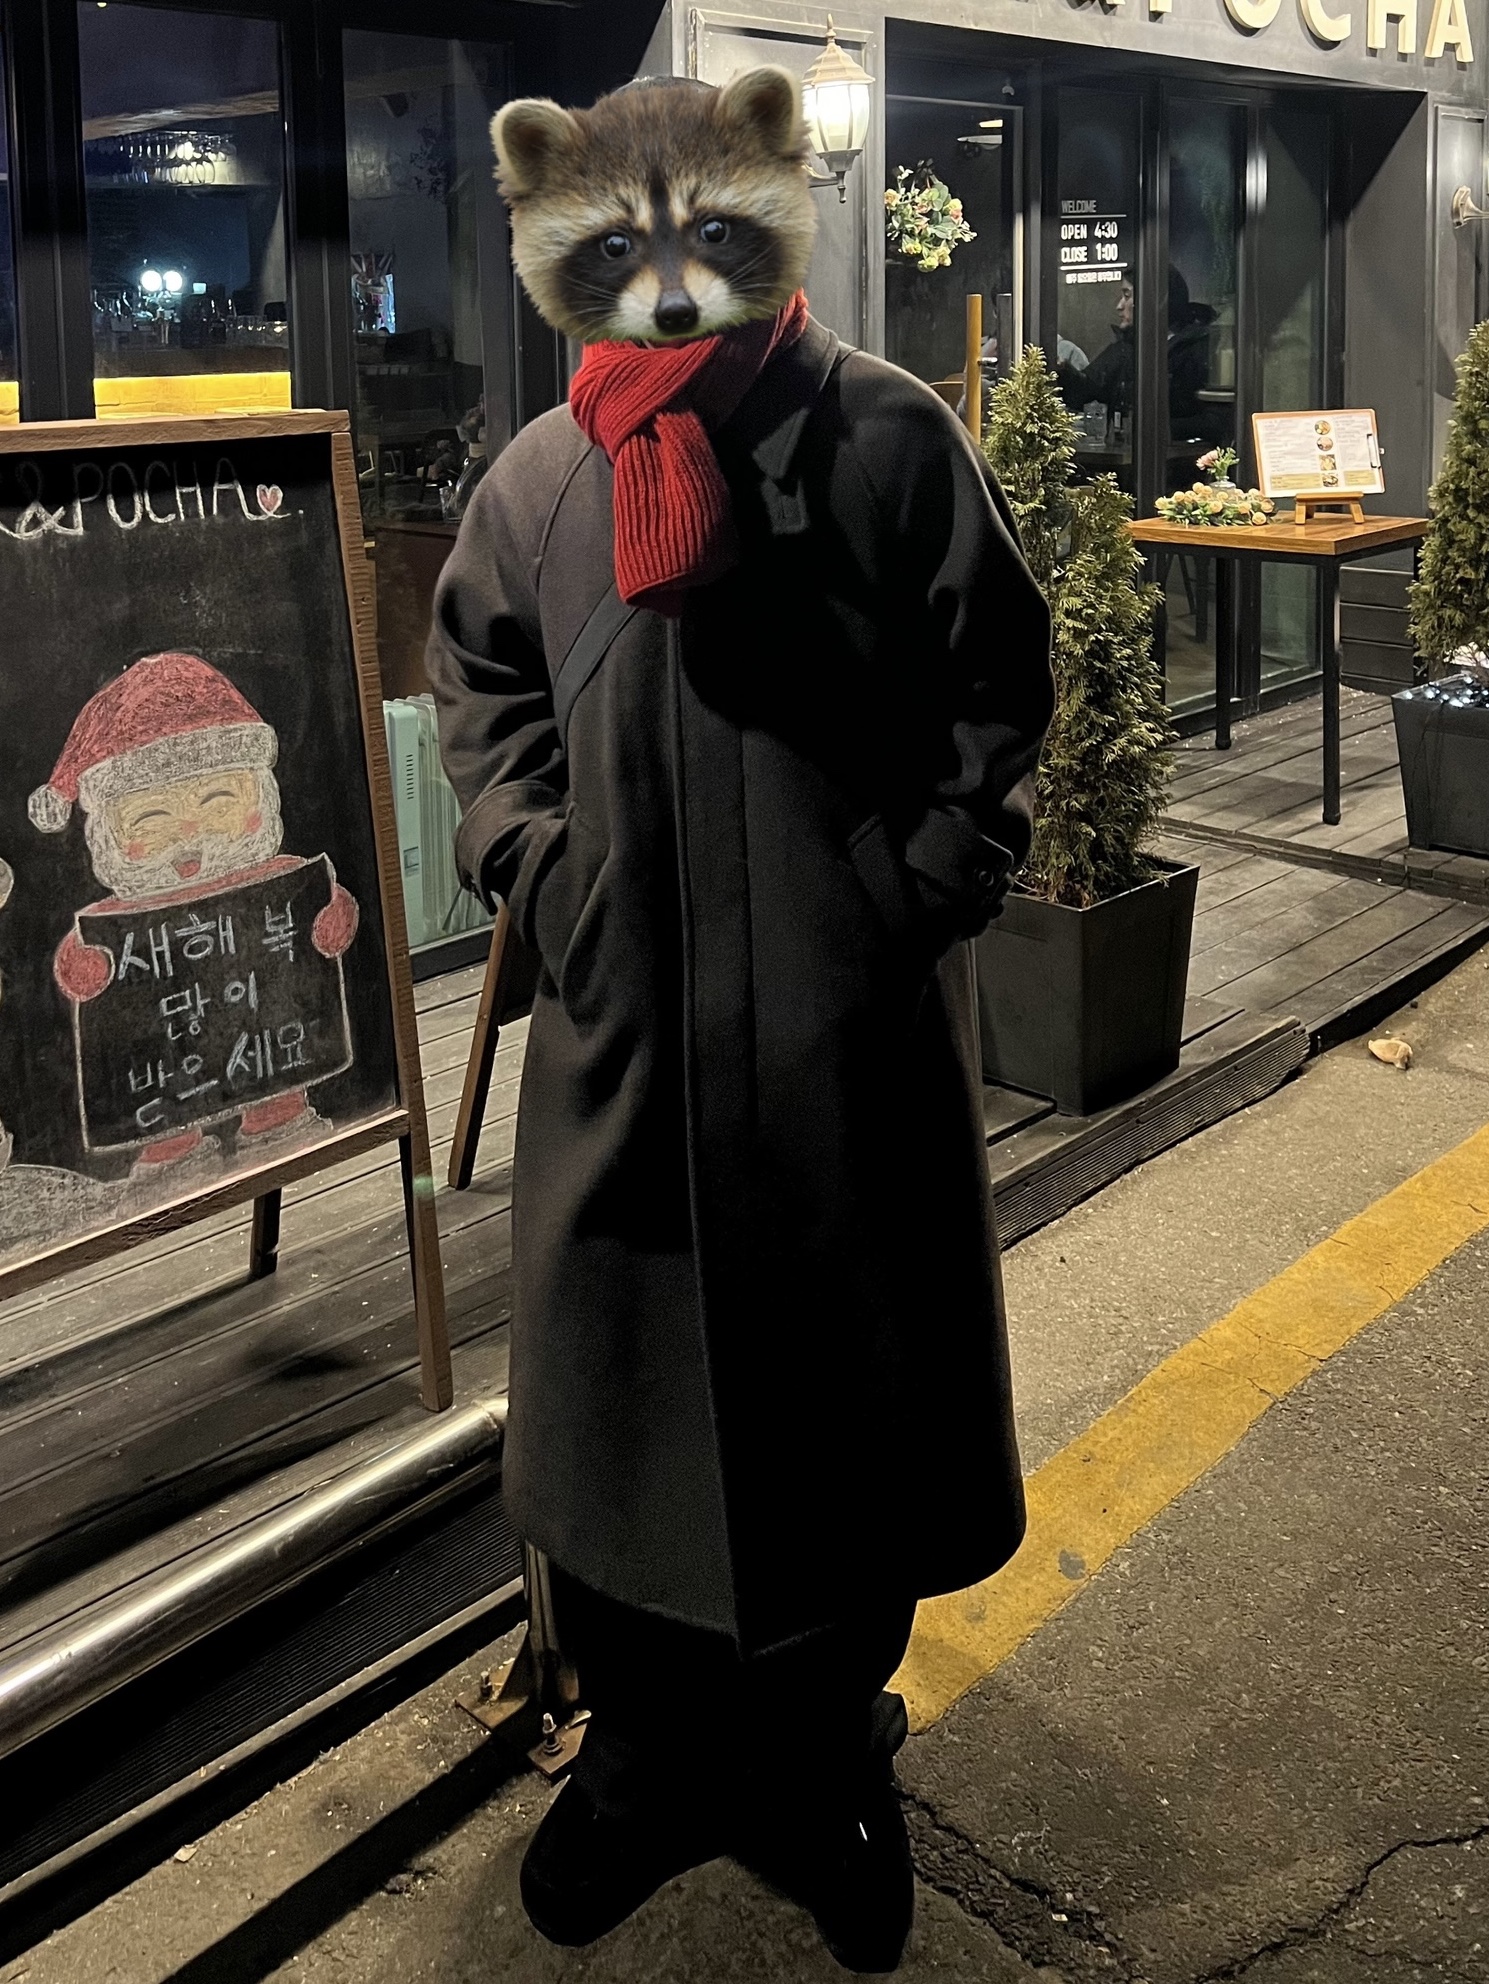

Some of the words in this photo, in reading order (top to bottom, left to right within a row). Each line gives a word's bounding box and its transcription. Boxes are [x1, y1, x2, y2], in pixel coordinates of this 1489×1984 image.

[1061, 200, 1097, 213] WELCOME
[1061, 224, 1087, 240] OPEN
[1094, 221, 1118, 239] 4:30
[1061, 246, 1088, 263] CLOSE
[1095, 242, 1118, 261] 1:00
[117, 913, 236, 981] 새해
[261, 901, 299, 963] 복
[159, 971, 259, 1041] 많이
